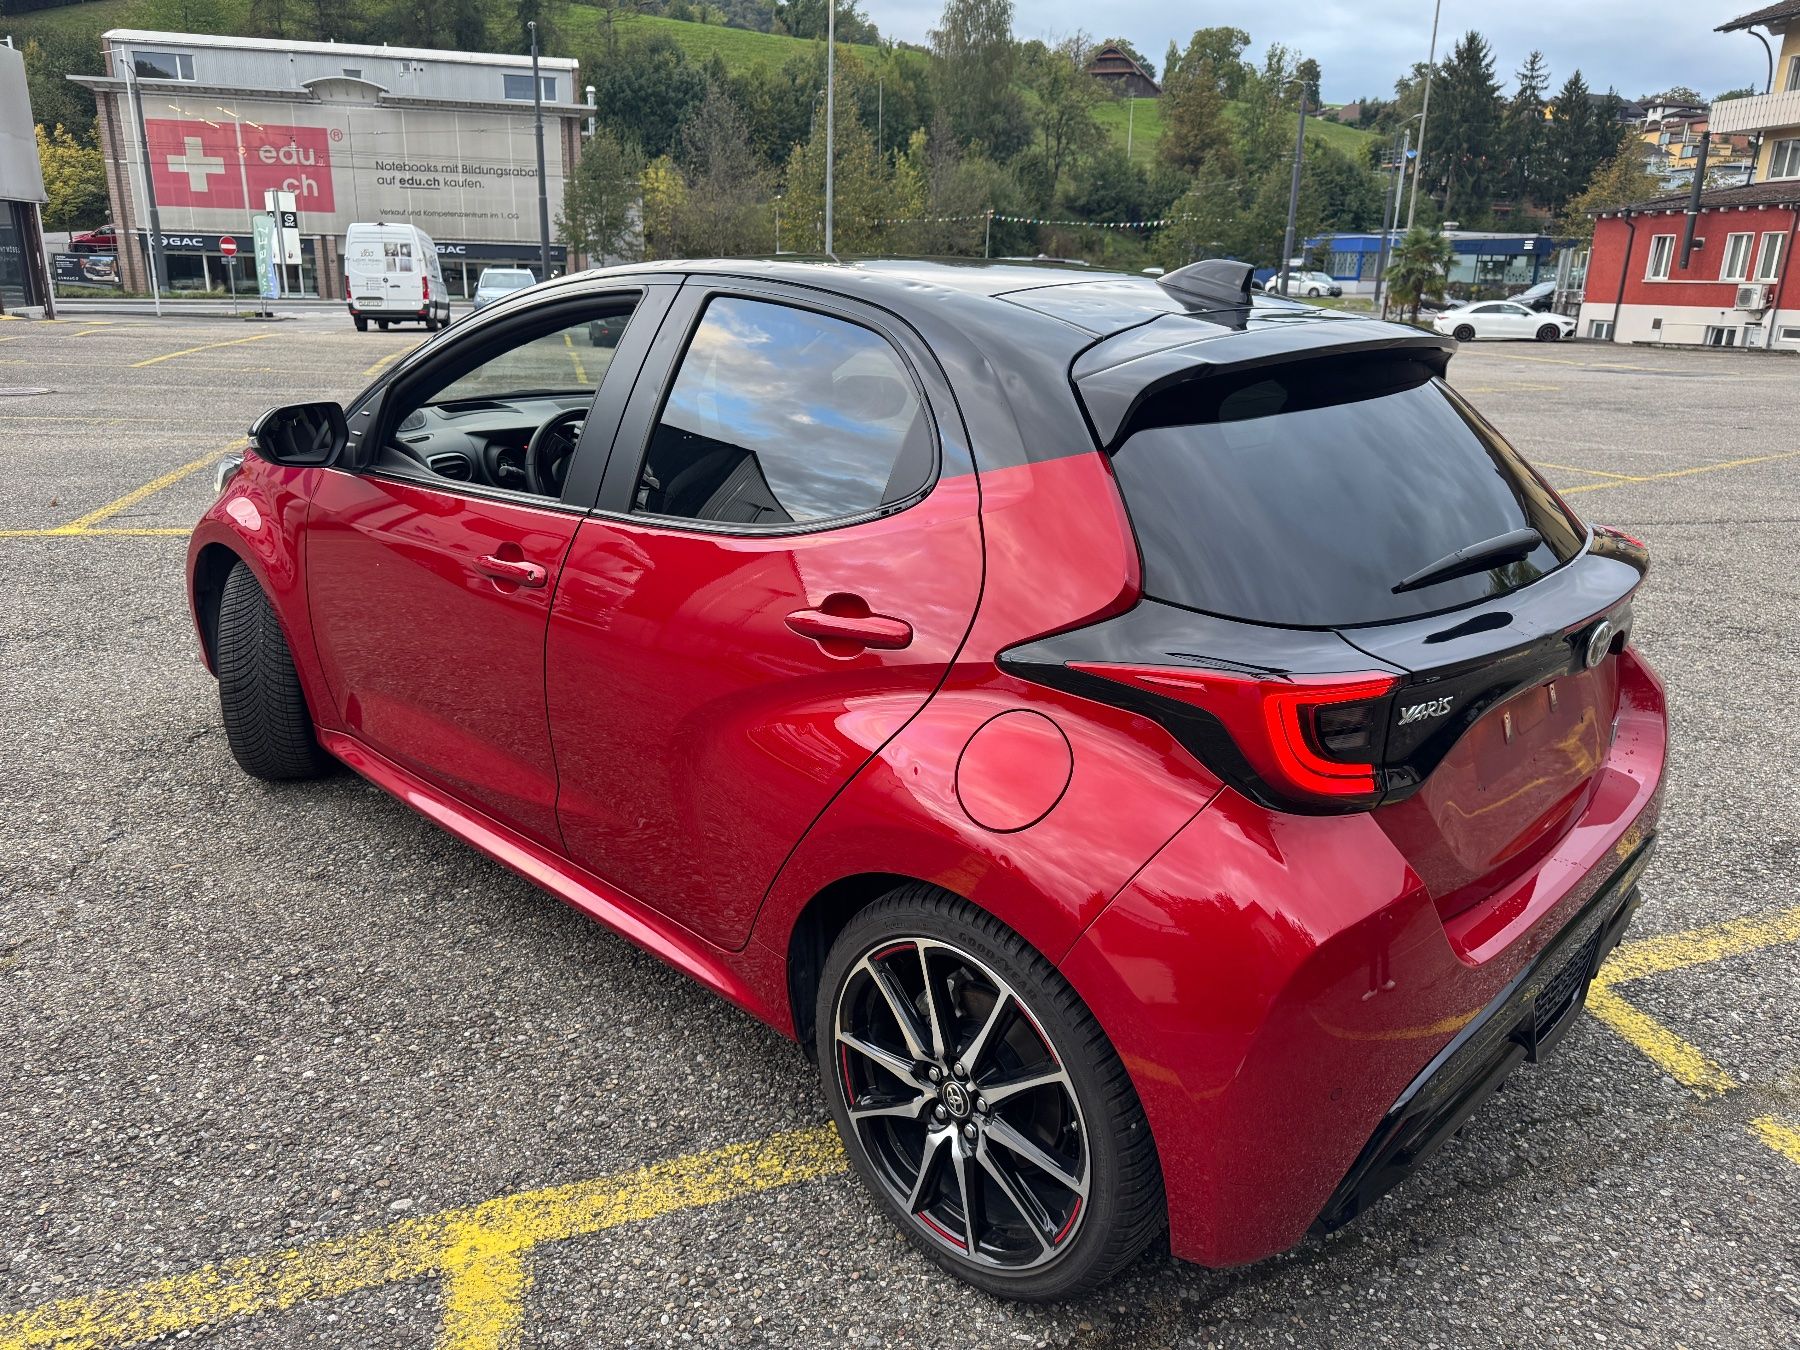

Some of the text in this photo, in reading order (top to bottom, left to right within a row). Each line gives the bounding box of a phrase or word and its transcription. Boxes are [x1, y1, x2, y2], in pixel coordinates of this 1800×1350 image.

[259, 143, 315, 165] edu
[375, 160, 438, 173] Notebooks
[441, 164, 458, 174] mit
[377, 175, 485, 189] auf edu.ch kaufen.
[380, 208, 406, 216] Verkauf
[407, 209, 421, 217] und
[423, 209, 488, 219] Kompetenzzentrum
[169, 237, 203, 247] GAC
[436, 245, 466, 254] GAC
